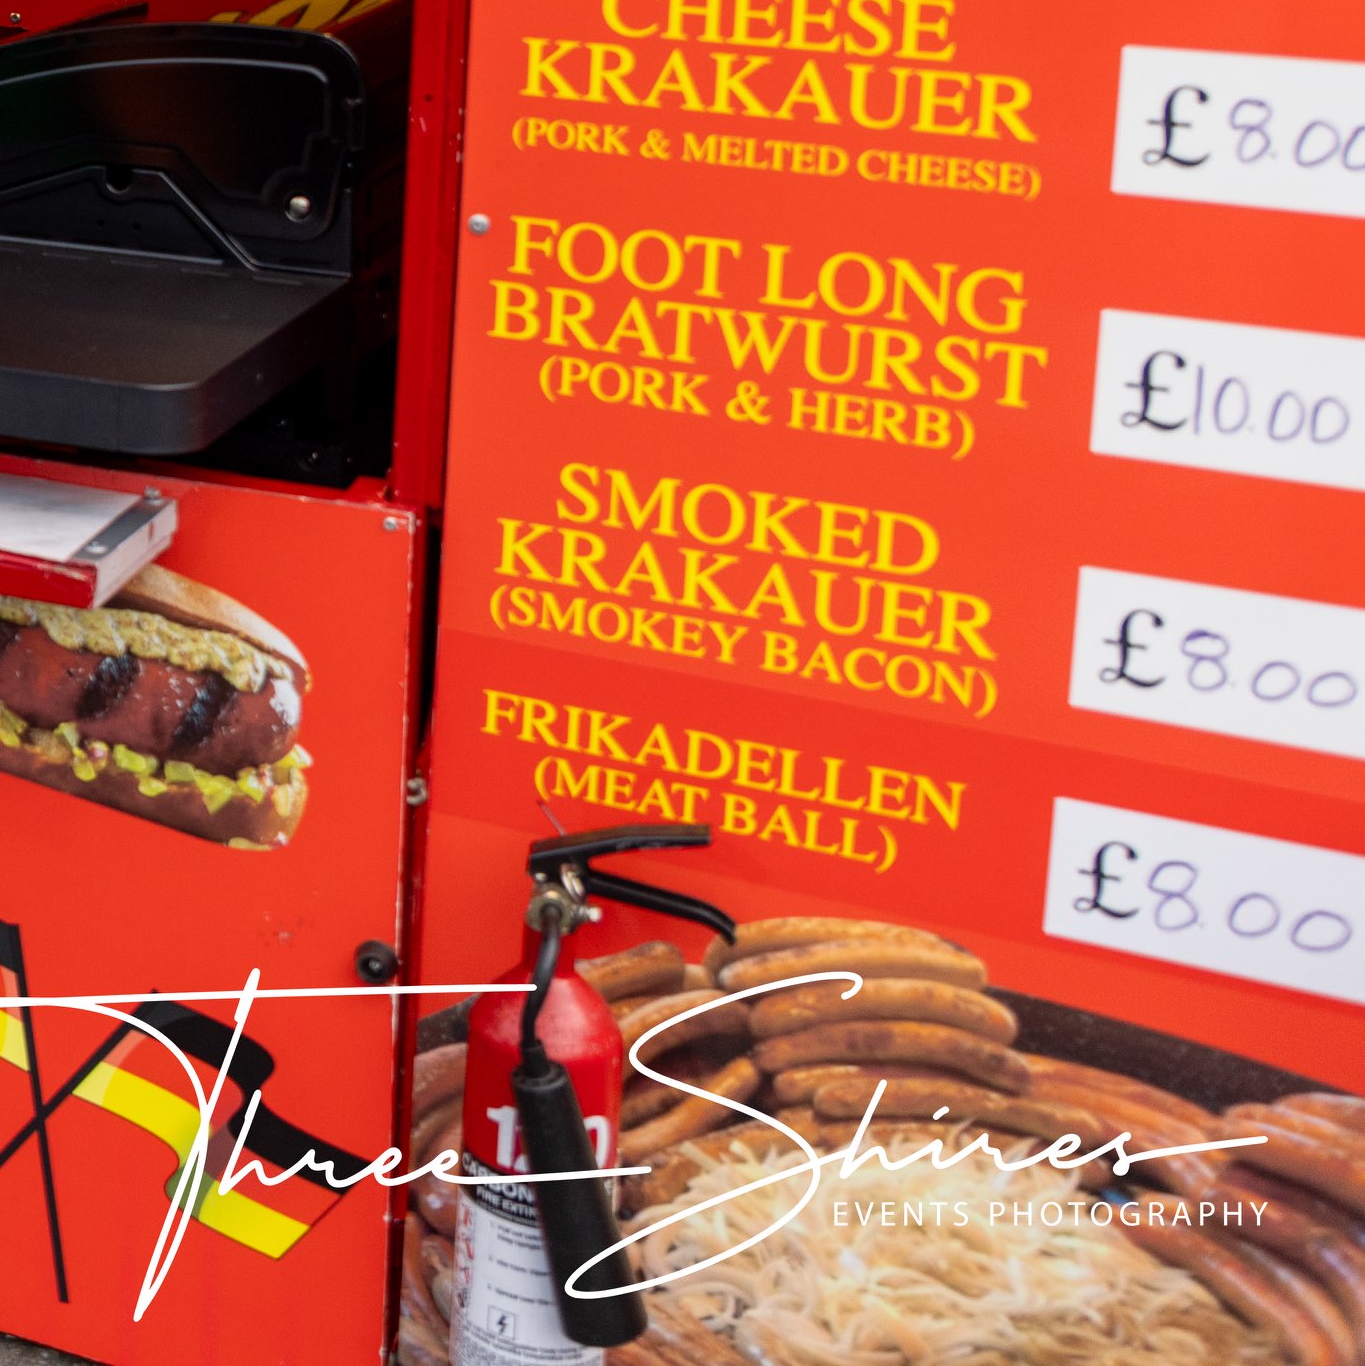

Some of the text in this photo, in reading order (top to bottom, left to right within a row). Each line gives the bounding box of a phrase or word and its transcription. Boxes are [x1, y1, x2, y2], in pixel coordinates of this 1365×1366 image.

[520, 36, 1038, 145] KRAKAUER
[511, 117, 1043, 201] (PORK & MELTED CHEESE)
[509, 215, 1028, 335] FOOT LONG
[487, 280, 1049, 410] BRATWURST
[539, 356, 975, 460] (PORK & HERB)
[556, 462, 940, 576] SMOKED
[493, 518, 998, 663] KRAKAUER
[490, 585, 998, 719] (SMOKEY BACON)
[480, 689, 968, 831] FRIKADELLEN
[533, 756, 897, 874] (MEAT BALL)
